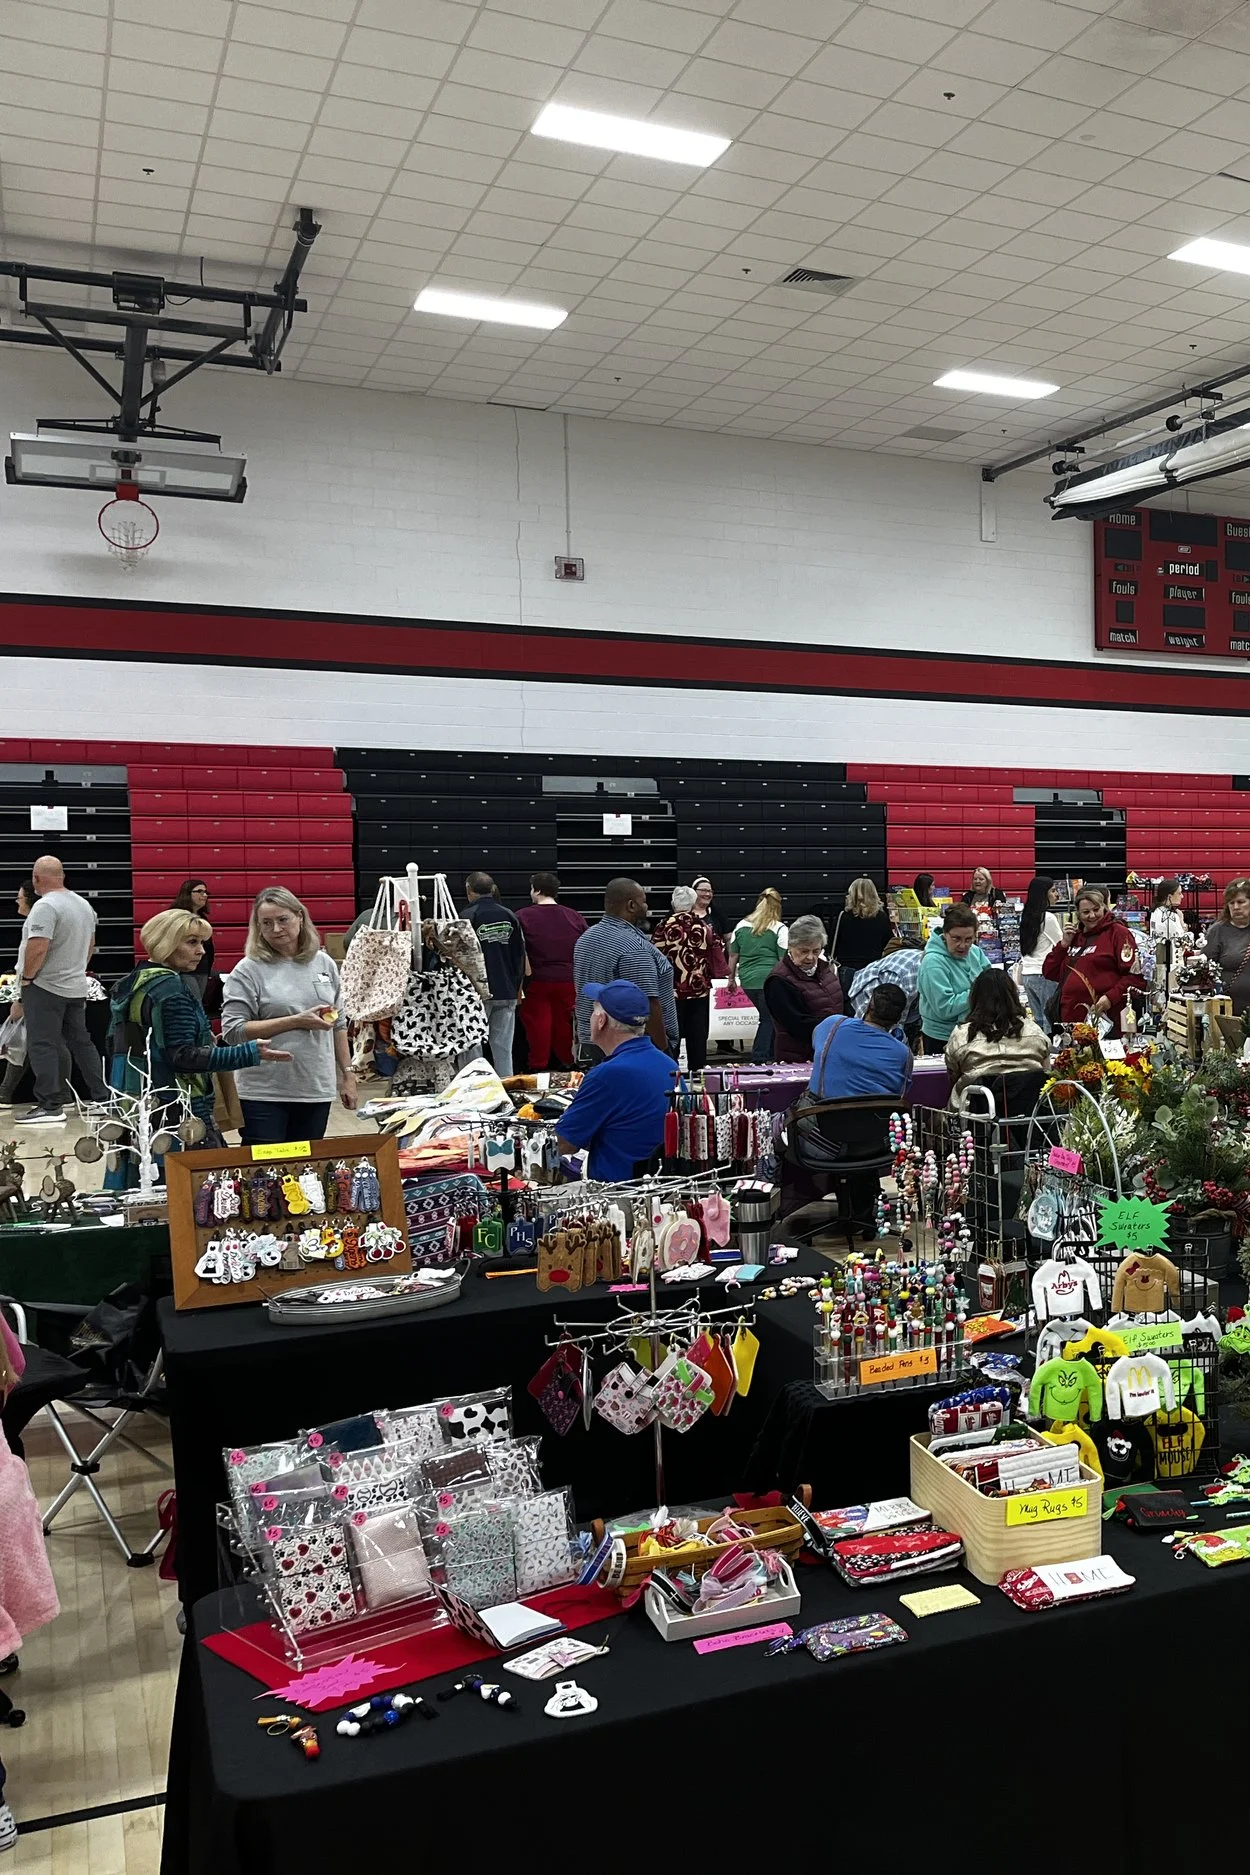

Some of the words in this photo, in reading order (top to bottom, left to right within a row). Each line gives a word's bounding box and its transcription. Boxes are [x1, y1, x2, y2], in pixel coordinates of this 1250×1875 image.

[1109, 513, 1136, 525] Home
[1169, 562, 1199, 576] period
[1112, 581, 1135, 595] fouls
[1169, 586, 1197, 600] player
[1109, 630, 1136, 643] match
[1168, 635, 1199, 647] weight
[1118, 1211, 1140, 1219] ELF
[1109, 1222, 1151, 1231] Sweaters
[477, 1228, 496, 1248] FC
[510, 1227, 534, 1247] PHS
[1127, 1232, 1138, 1240] $5
[1051, 1278, 1078, 1290] Arby's
[1122, 1334, 1138, 1345] Elf
[1140, 1331, 1175, 1342] Sweaters
[869, 1362, 894, 1374] Beaded
[1019, 1503, 1038, 1518] Mug
[1041, 1499, 1068, 1516] Rugs
[1071, 1496, 1083, 1509] $5
